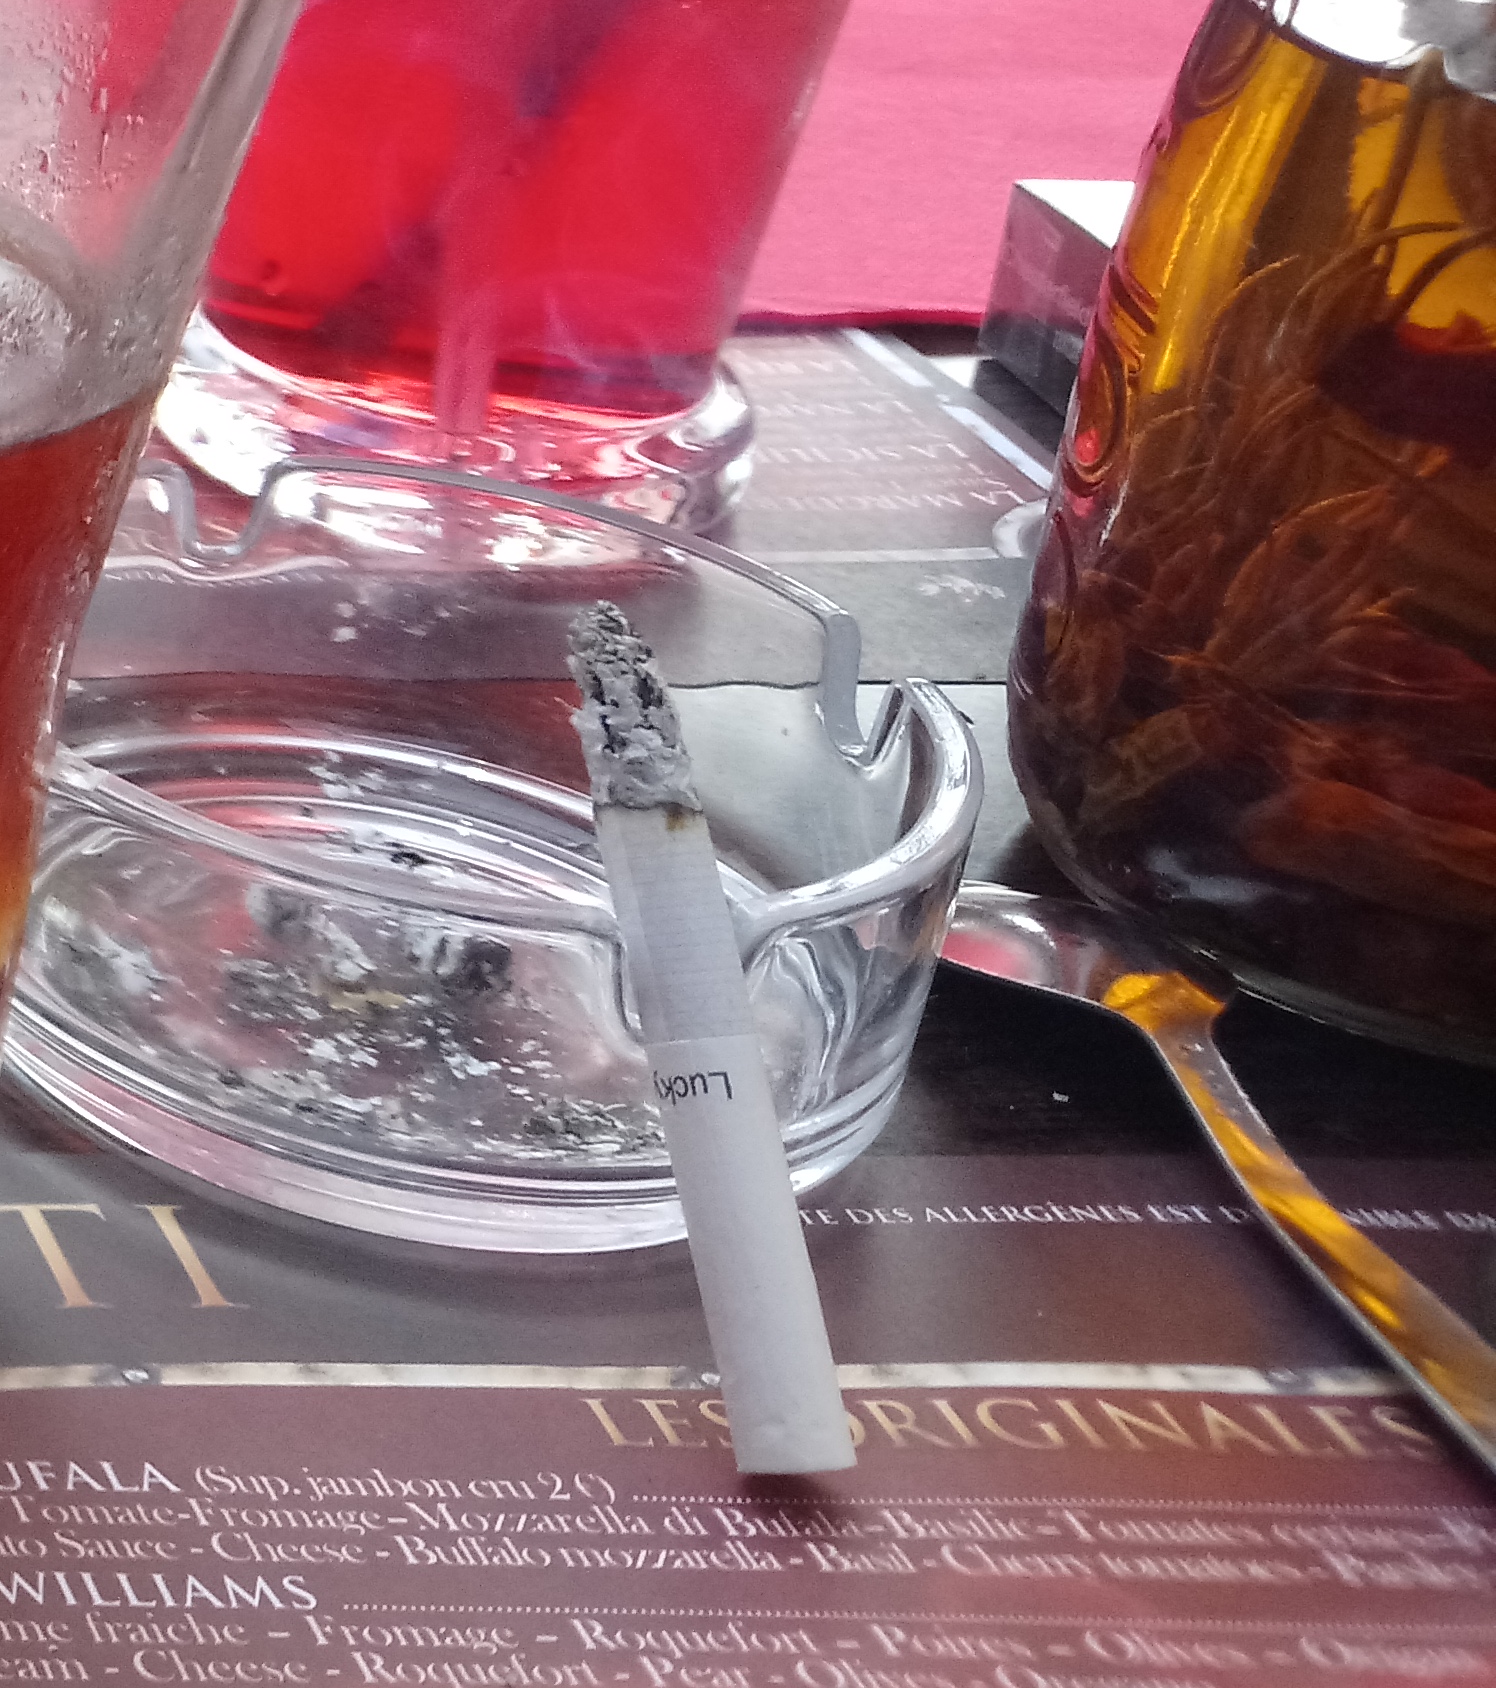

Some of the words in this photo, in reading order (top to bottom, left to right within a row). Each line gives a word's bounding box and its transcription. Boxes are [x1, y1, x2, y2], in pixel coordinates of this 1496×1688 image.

[844, 1207, 914, 1226] DES
[847, 1397, 1437, 1459] RIGINALES
[662, 1506, 709, 1537] di
[53, 1528, 180, 1562] Sauce
[210, 1530, 367, 1564] Cheese
[393, 1535, 552, 1568] Buffalo
[302, 1613, 520, 1655] Fromage
[132, 1647, 313, 1684] Cheese
